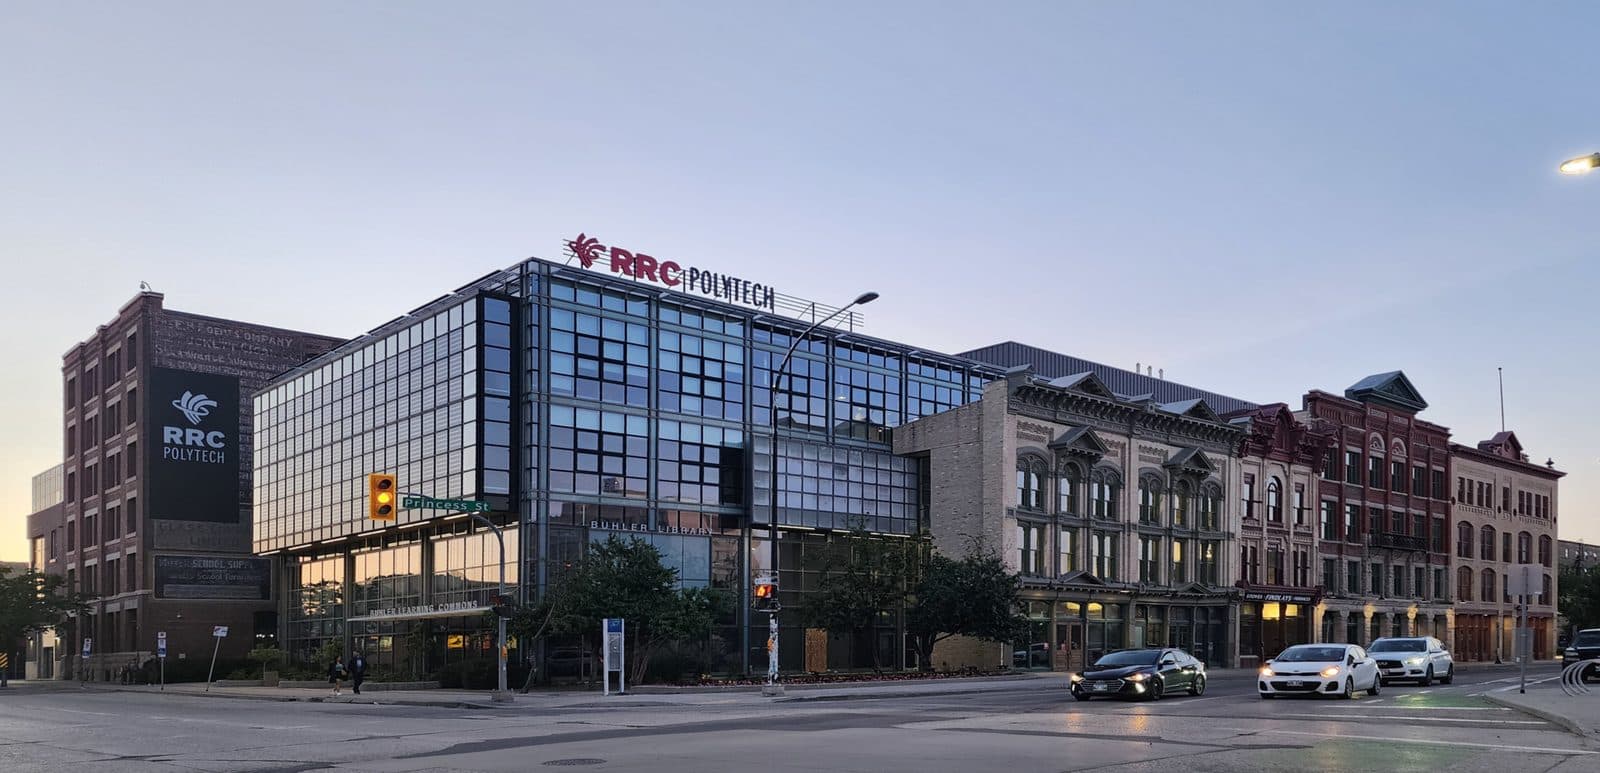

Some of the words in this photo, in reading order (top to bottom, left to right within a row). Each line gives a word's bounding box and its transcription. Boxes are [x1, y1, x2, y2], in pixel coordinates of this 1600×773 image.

[610, 246, 682, 286] RRC
[689, 267, 774, 309] POLYTECH
[163, 426, 226, 448] RRC
[163, 447, 225, 464] POLYTECH
[404, 498, 468, 512] Princess
[475, 501, 489, 512] St
[590, 520, 648, 532] BUHLER
[658, 525, 713, 536] LIBRARY
[370, 606, 397, 617] BUHLER
[398, 604, 435, 615] LEARNING
[438, 600, 478, 611] COMMONS
